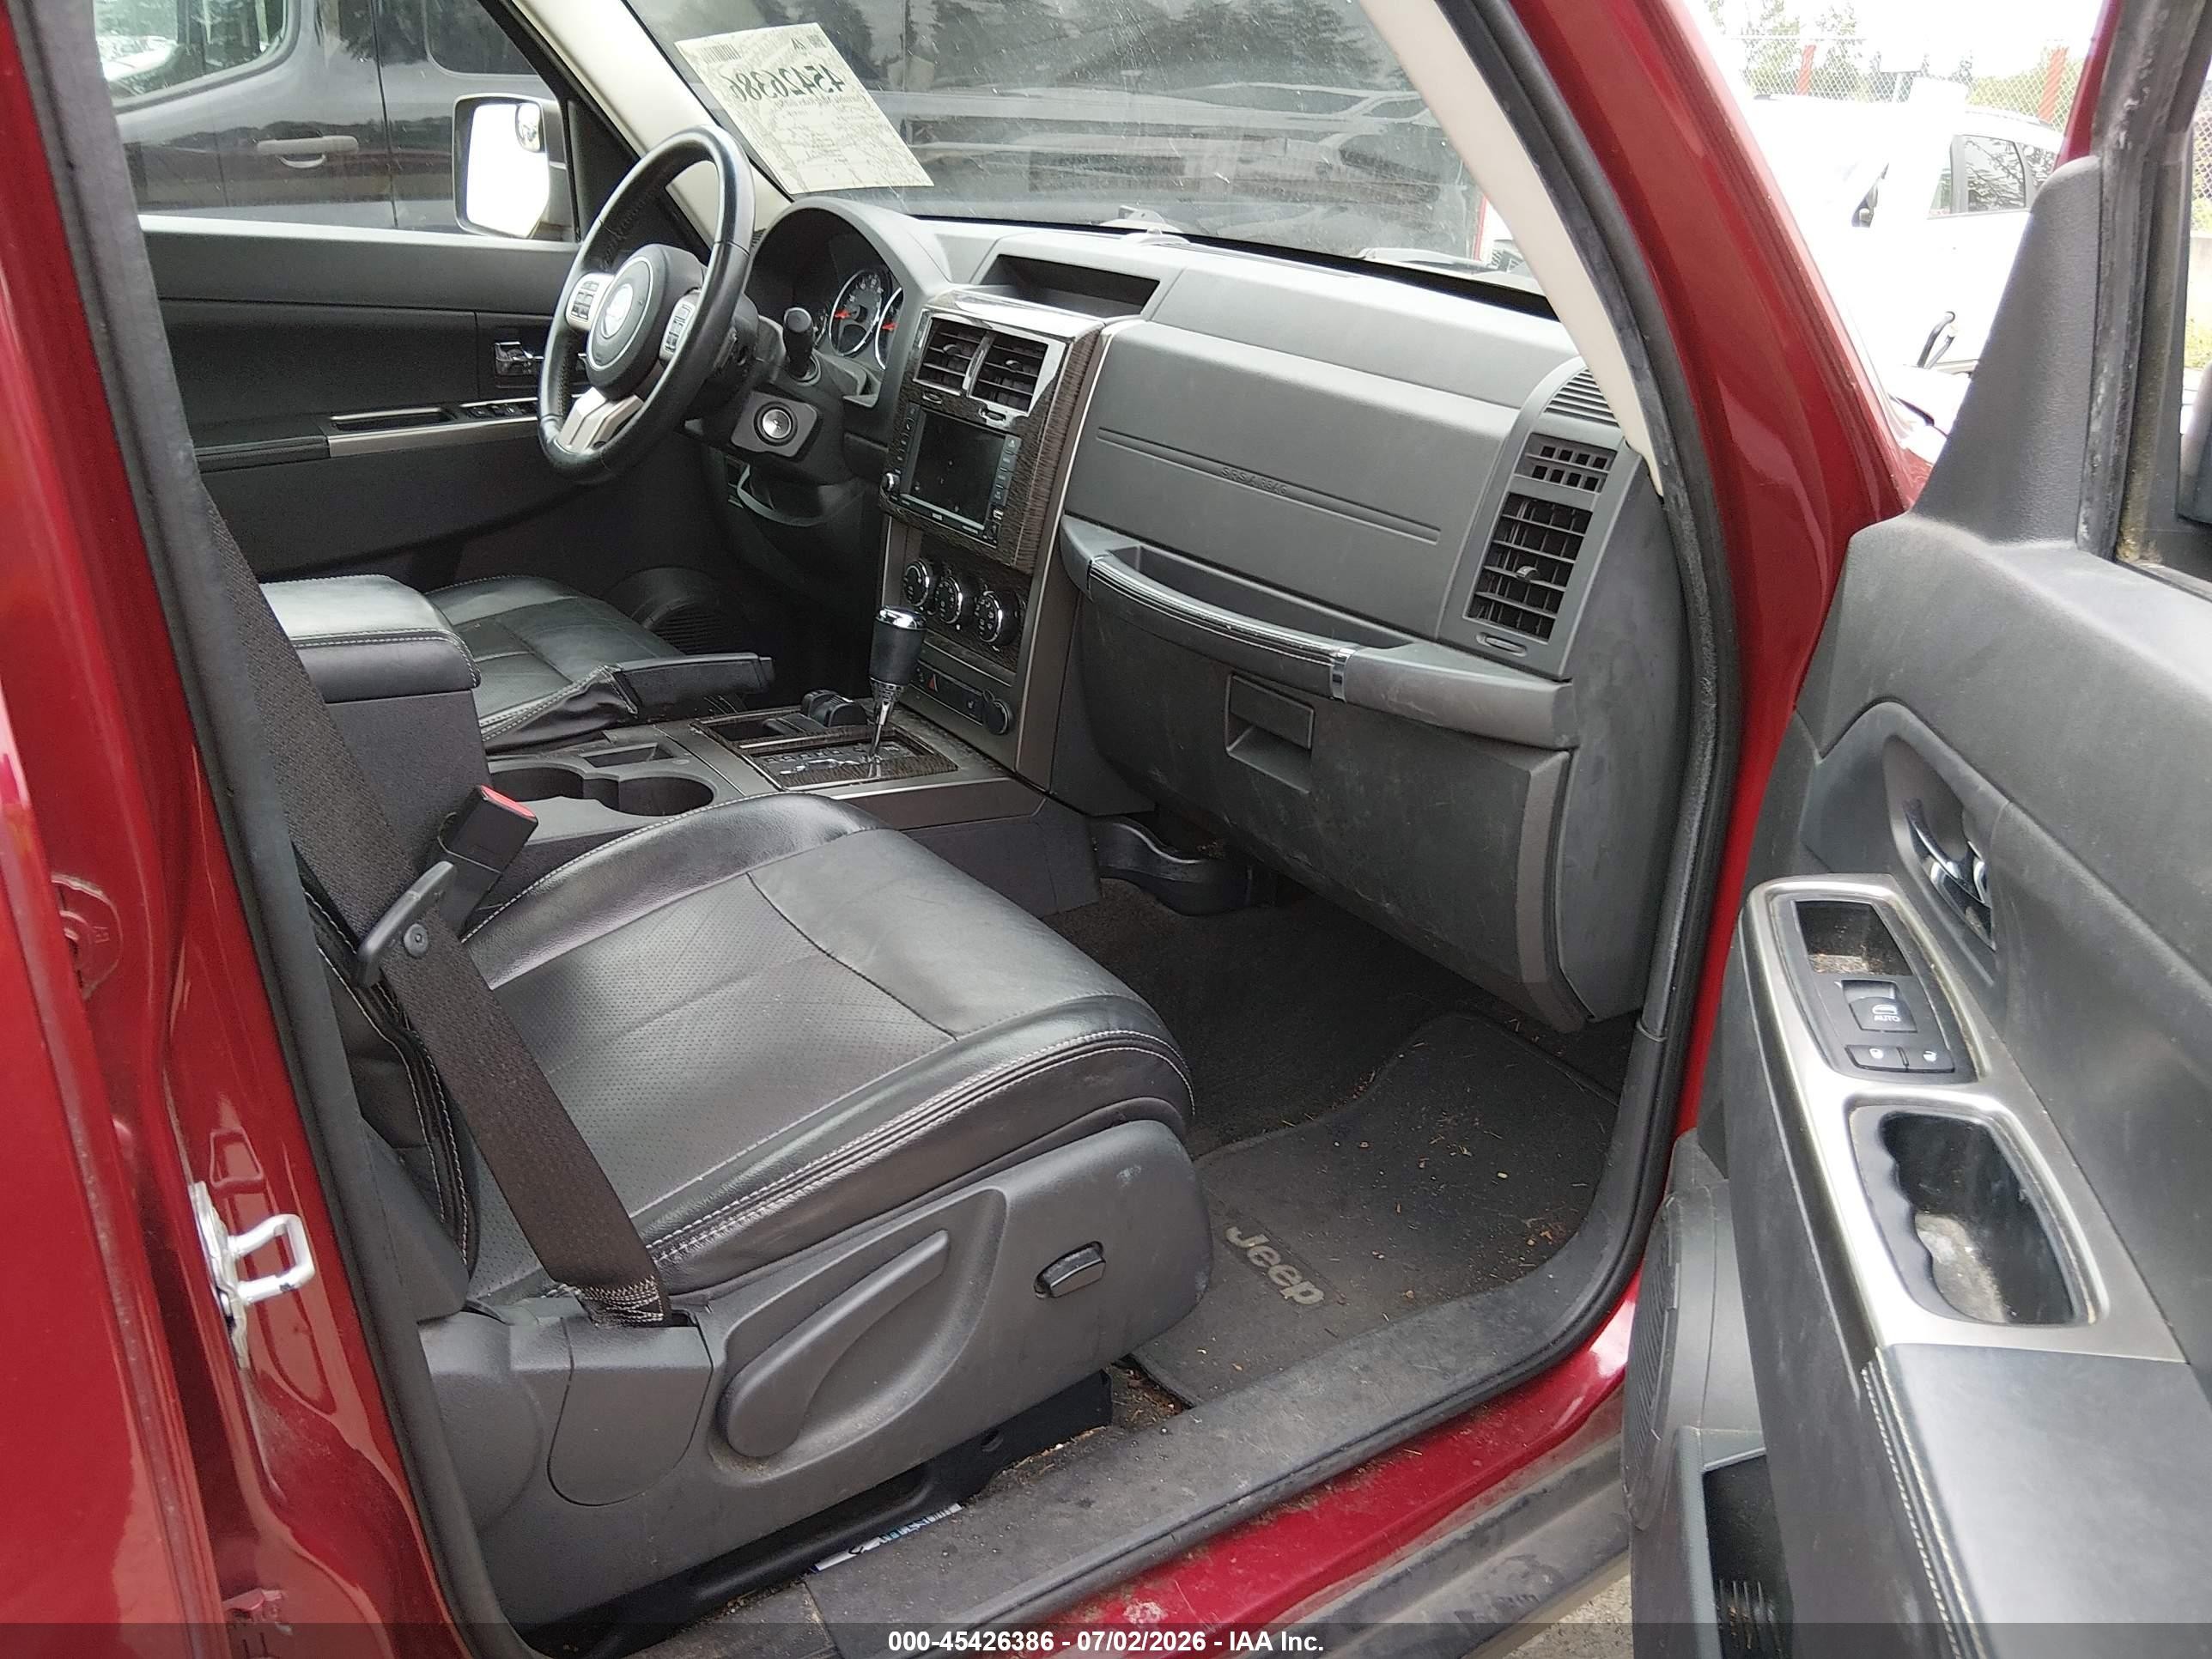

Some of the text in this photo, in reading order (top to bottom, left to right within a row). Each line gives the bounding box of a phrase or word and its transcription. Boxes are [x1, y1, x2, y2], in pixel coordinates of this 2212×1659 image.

[1221, 466, 1288, 495] SRS AIRBAG
[1874, 1014, 1901, 1023] AUTO
[1224, 1225, 1325, 1305] Jeep
